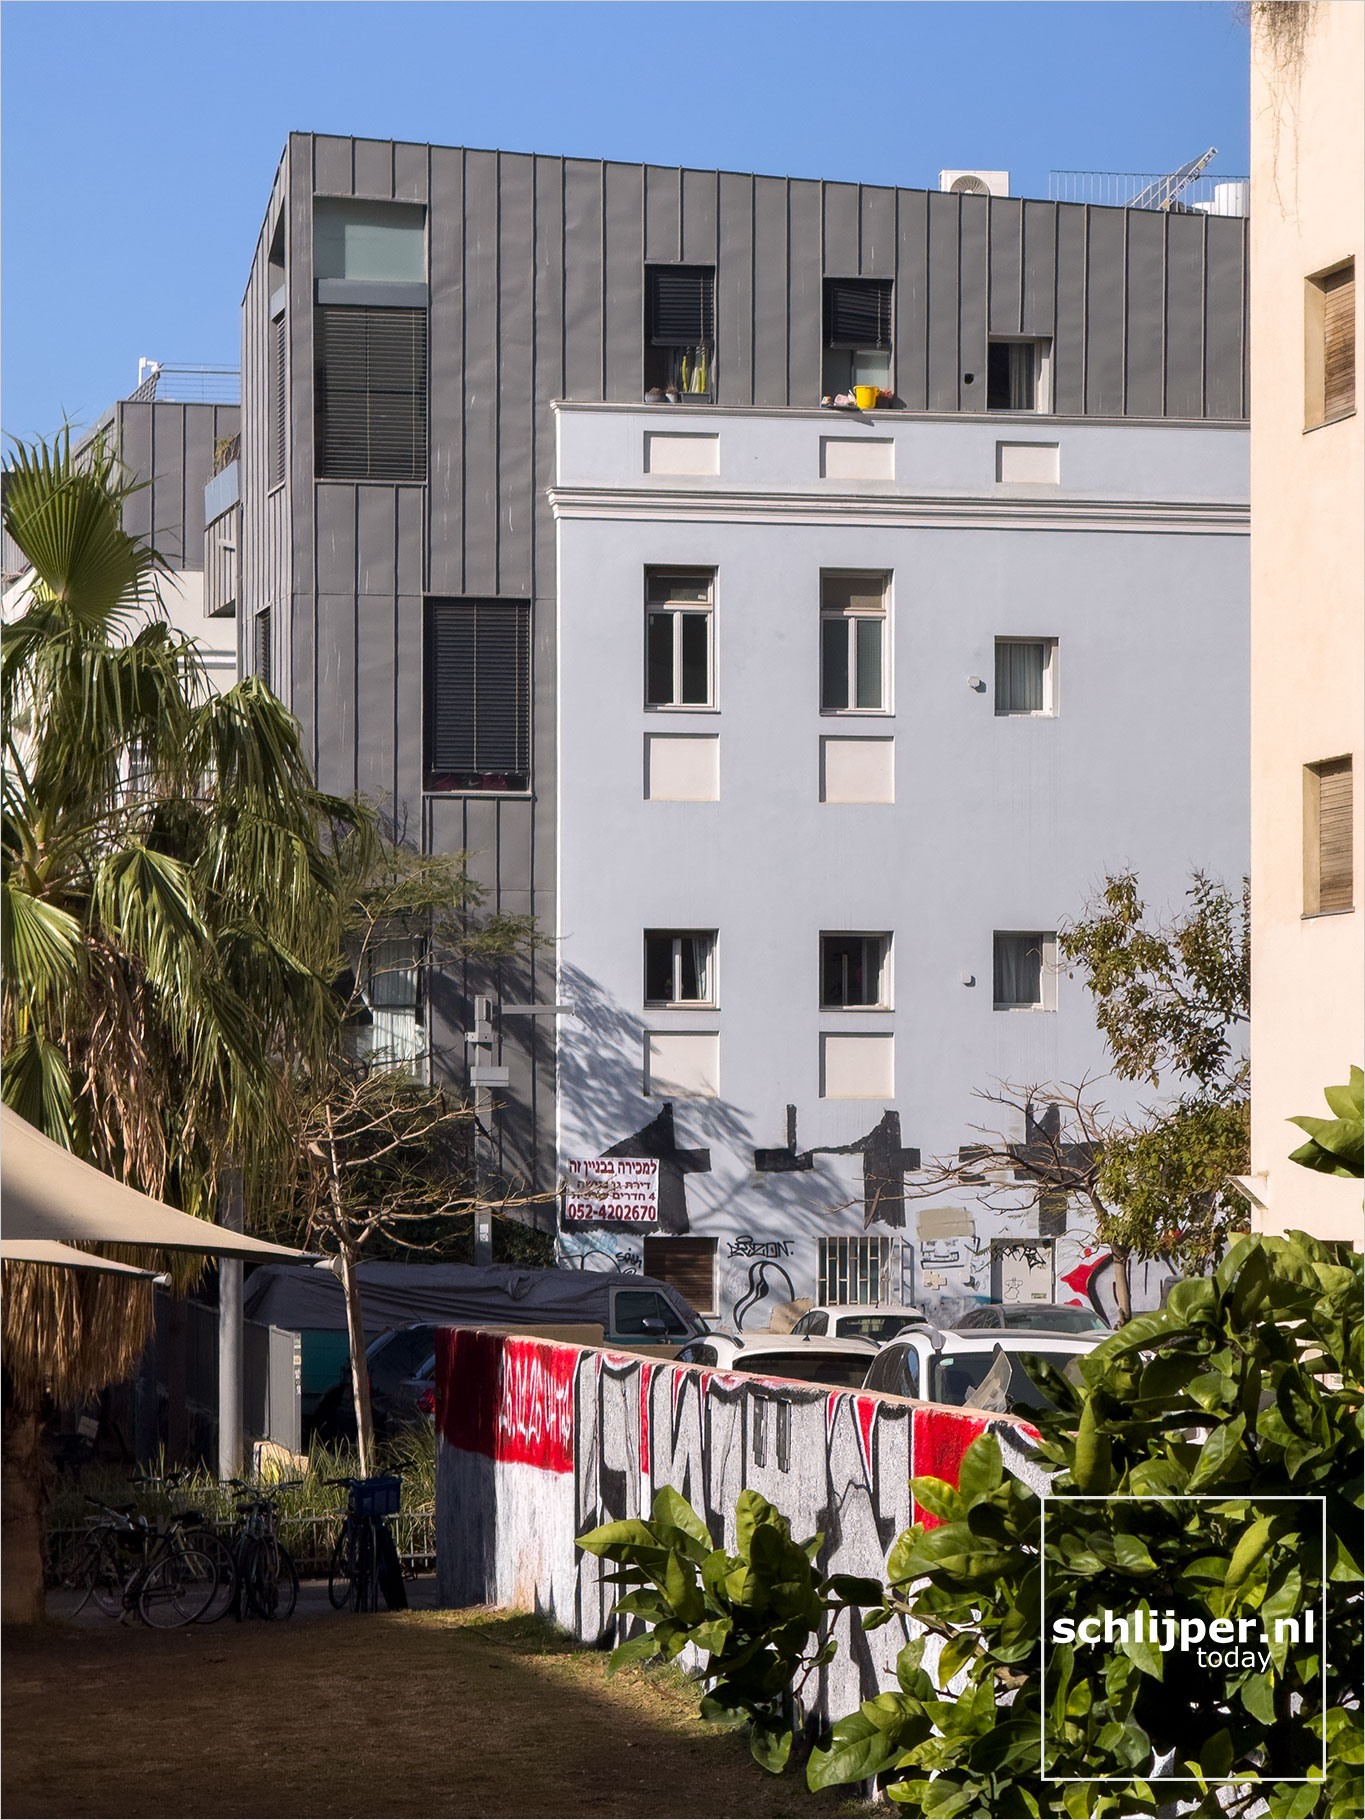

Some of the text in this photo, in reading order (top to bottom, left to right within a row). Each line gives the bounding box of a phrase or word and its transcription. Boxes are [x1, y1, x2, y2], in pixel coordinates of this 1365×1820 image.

[569, 1159, 657, 1177] למכירה בבניין זה
[625, 1181, 651, 1190] דירת
[612, 1192, 646, 1201] חדרים
[648, 1192, 656, 1201] 4
[568, 1203, 657, 1221] 052-4202670
